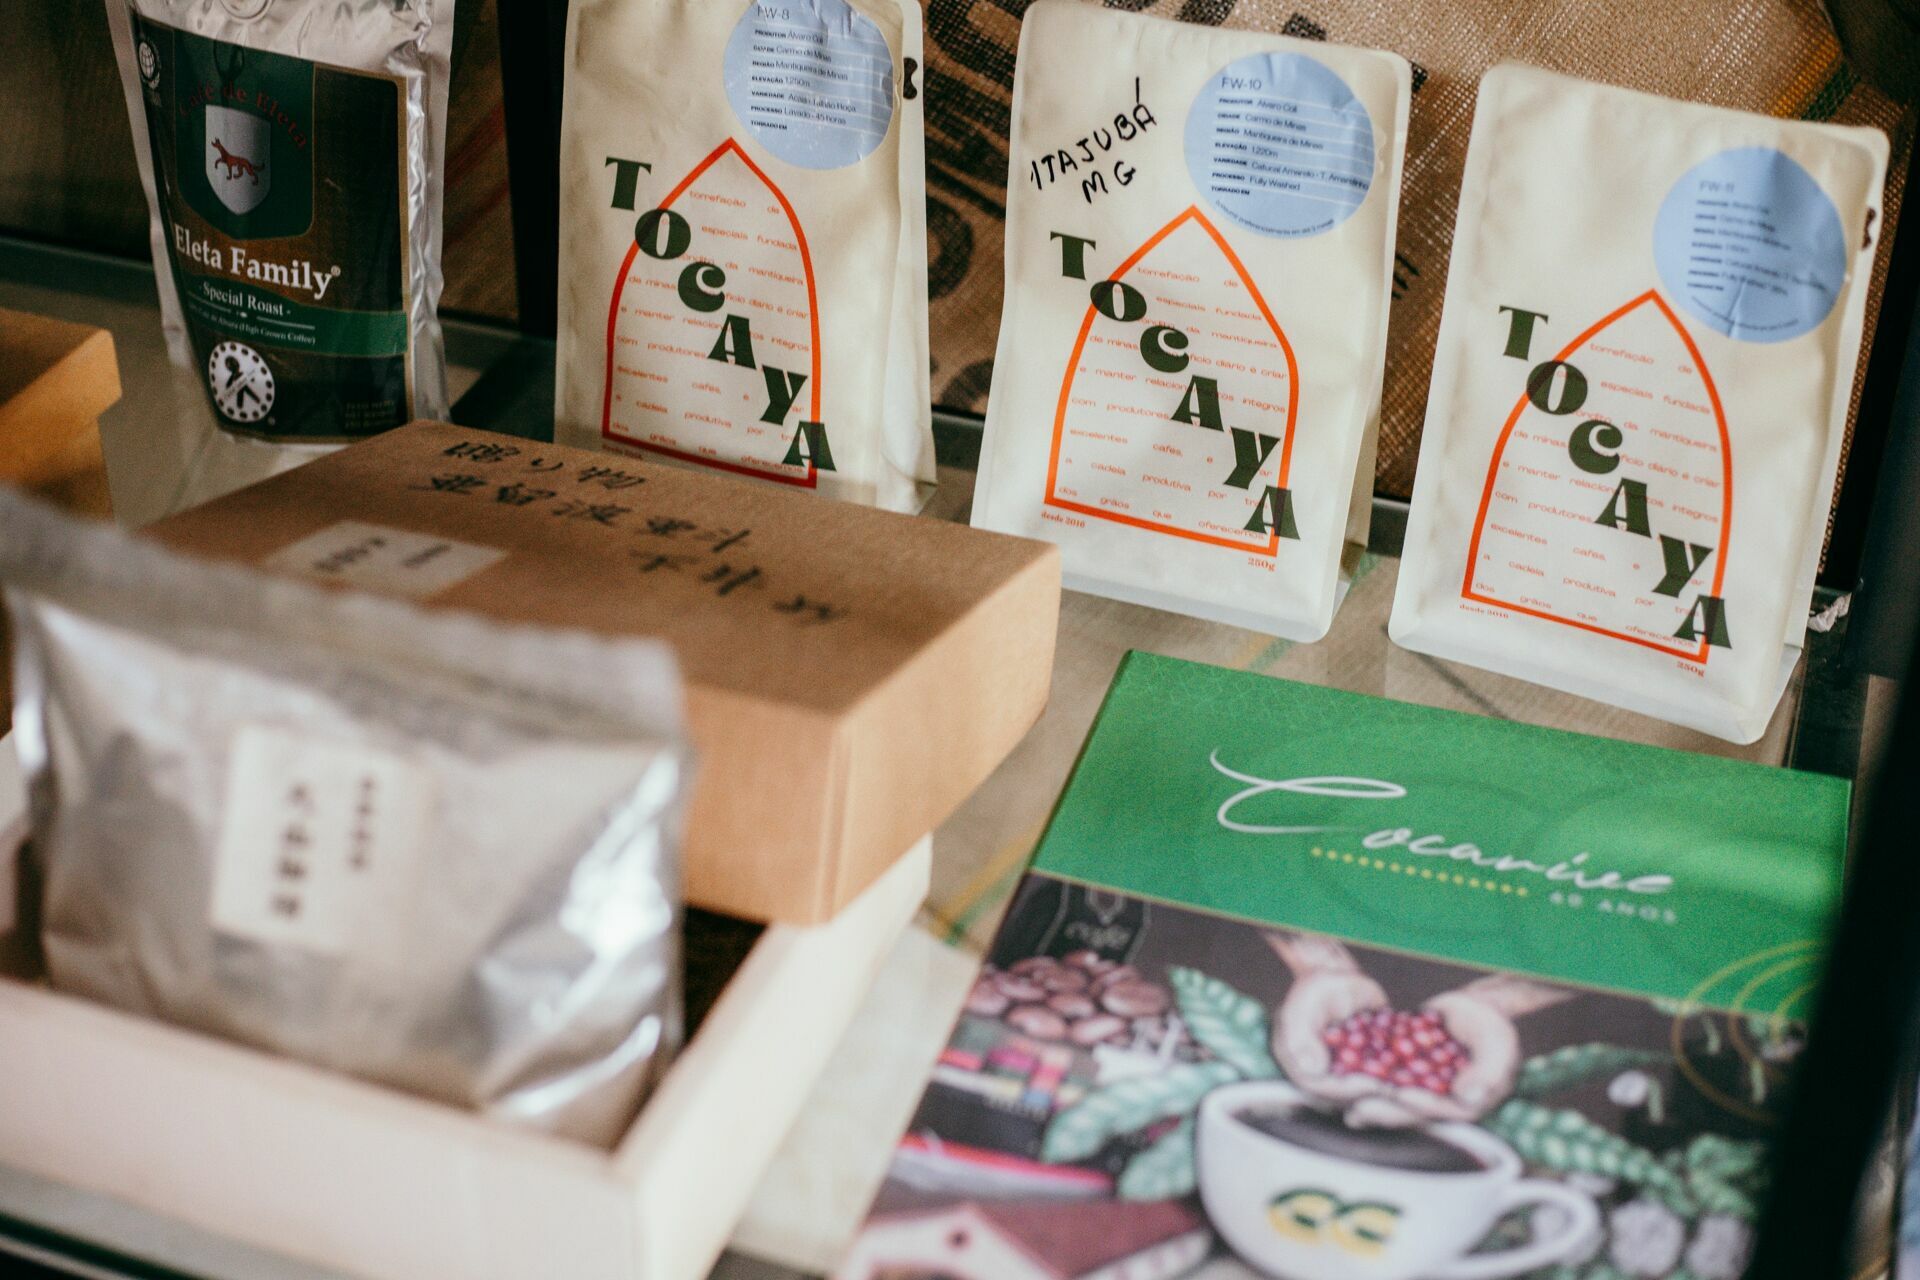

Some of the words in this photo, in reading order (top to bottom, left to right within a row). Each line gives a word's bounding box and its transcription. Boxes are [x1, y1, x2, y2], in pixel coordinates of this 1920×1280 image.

[223, 80, 247, 102] de
[1221, 77, 1262, 90] FW-10
[1245, 113, 1272, 126] Carmo
[1284, 120, 1306, 132] Minas
[1215, 142, 1247, 151] ELEVAÇÃO
[1243, 129, 1288, 145] Mantiqueira
[1249, 175, 1267, 188] Fully
[1268, 181, 1300, 191] Washed
[767, 206, 780, 215] de
[174, 223, 222, 270] Eleta
[701, 224, 749, 240] especiais
[757, 235, 797, 253] fundada
[725, 262, 738, 271] da
[748, 266, 803, 285] mantiqueira
[1224, 279, 1238, 288] de
[202, 281, 242, 306] Special
[247, 294, 284, 316] Roast
[645, 278, 676, 291] minas
[786, 308, 809, 319] criar
[1156, 296, 1206, 312] especiais
[1216, 307, 1262, 321] fundada
[635, 309, 674, 321] manter
[617, 336, 638, 345] com
[1186, 326, 1200, 335] da
[1211, 331, 1278, 349] mantiqueira
[1090, 336, 1103, 344] de
[1107, 339, 1139, 351] minas
[1261, 369, 1287, 380] criar
[617, 364, 668, 383] excelentes
[1096, 368, 1136, 381] manter
[1678, 364, 1692, 375] de
[1071, 397, 1096, 408] com
[1601, 380, 1653, 400] especiais
[1663, 395, 1710, 415] fundada
[636, 400, 668, 414] cadeia
[684, 411, 732, 429] produtiva
[747, 427, 764, 435] por
[1070, 428, 1128, 444] excelentes
[1206, 455, 1213, 464] e
[1624, 420, 1638, 431] da
[1650, 428, 1717, 453] mantiqueira
[1514, 429, 1528, 440] de
[1532, 432, 1568, 448] minas
[1694, 475, 1720, 489] criar
[1090, 461, 1126, 476] cadeia
[1142, 473, 1191, 492] produtiva
[1208, 489, 1227, 500] por
[1518, 465, 1561, 481] manter
[1059, 485, 1078, 497] dos
[1153, 508, 1172, 520] que
[1495, 490, 1518, 504] com
[1041, 510, 1064, 524] desde
[1490, 522, 1548, 545] excelentes
[1248, 556, 1275, 572] 250g
[1508, 560, 1544, 577] cadeia
[1562, 576, 1616, 598] produtiva
[1634, 596, 1655, 607] por
[1476, 581, 1495, 593] dos
[1576, 611, 1598, 622] que
[1677, 661, 1705, 678] 250g
